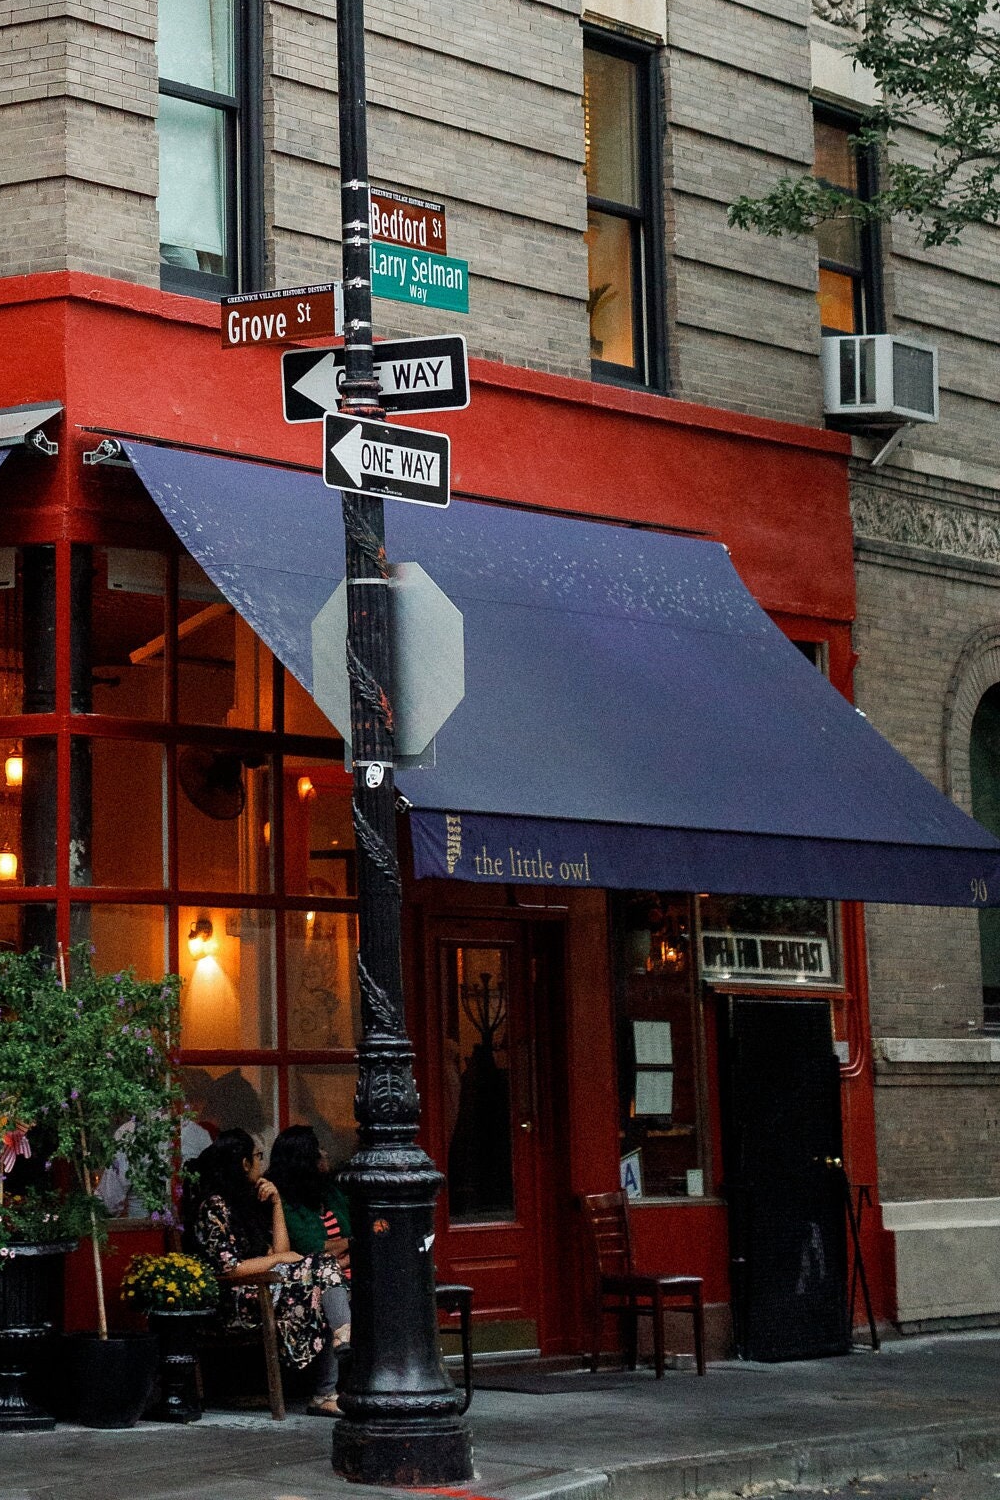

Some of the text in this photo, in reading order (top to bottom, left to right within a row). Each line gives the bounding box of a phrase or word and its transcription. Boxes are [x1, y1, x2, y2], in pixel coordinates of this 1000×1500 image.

[371, 202, 442, 247] Bedford St
[372, 247, 463, 291] Larry Selman
[227, 284, 332, 304] GREENWICH VILLAGE HISTORIC DISTRICT
[409, 283, 428, 303] Way
[228, 302, 311, 344] Grove St
[392, 360, 444, 390] WAY
[361, 443, 435, 482] ONE WAY
[474, 844, 591, 881] the little owl
[970, 877, 988, 903] 90
[625, 1161, 638, 1191] A
